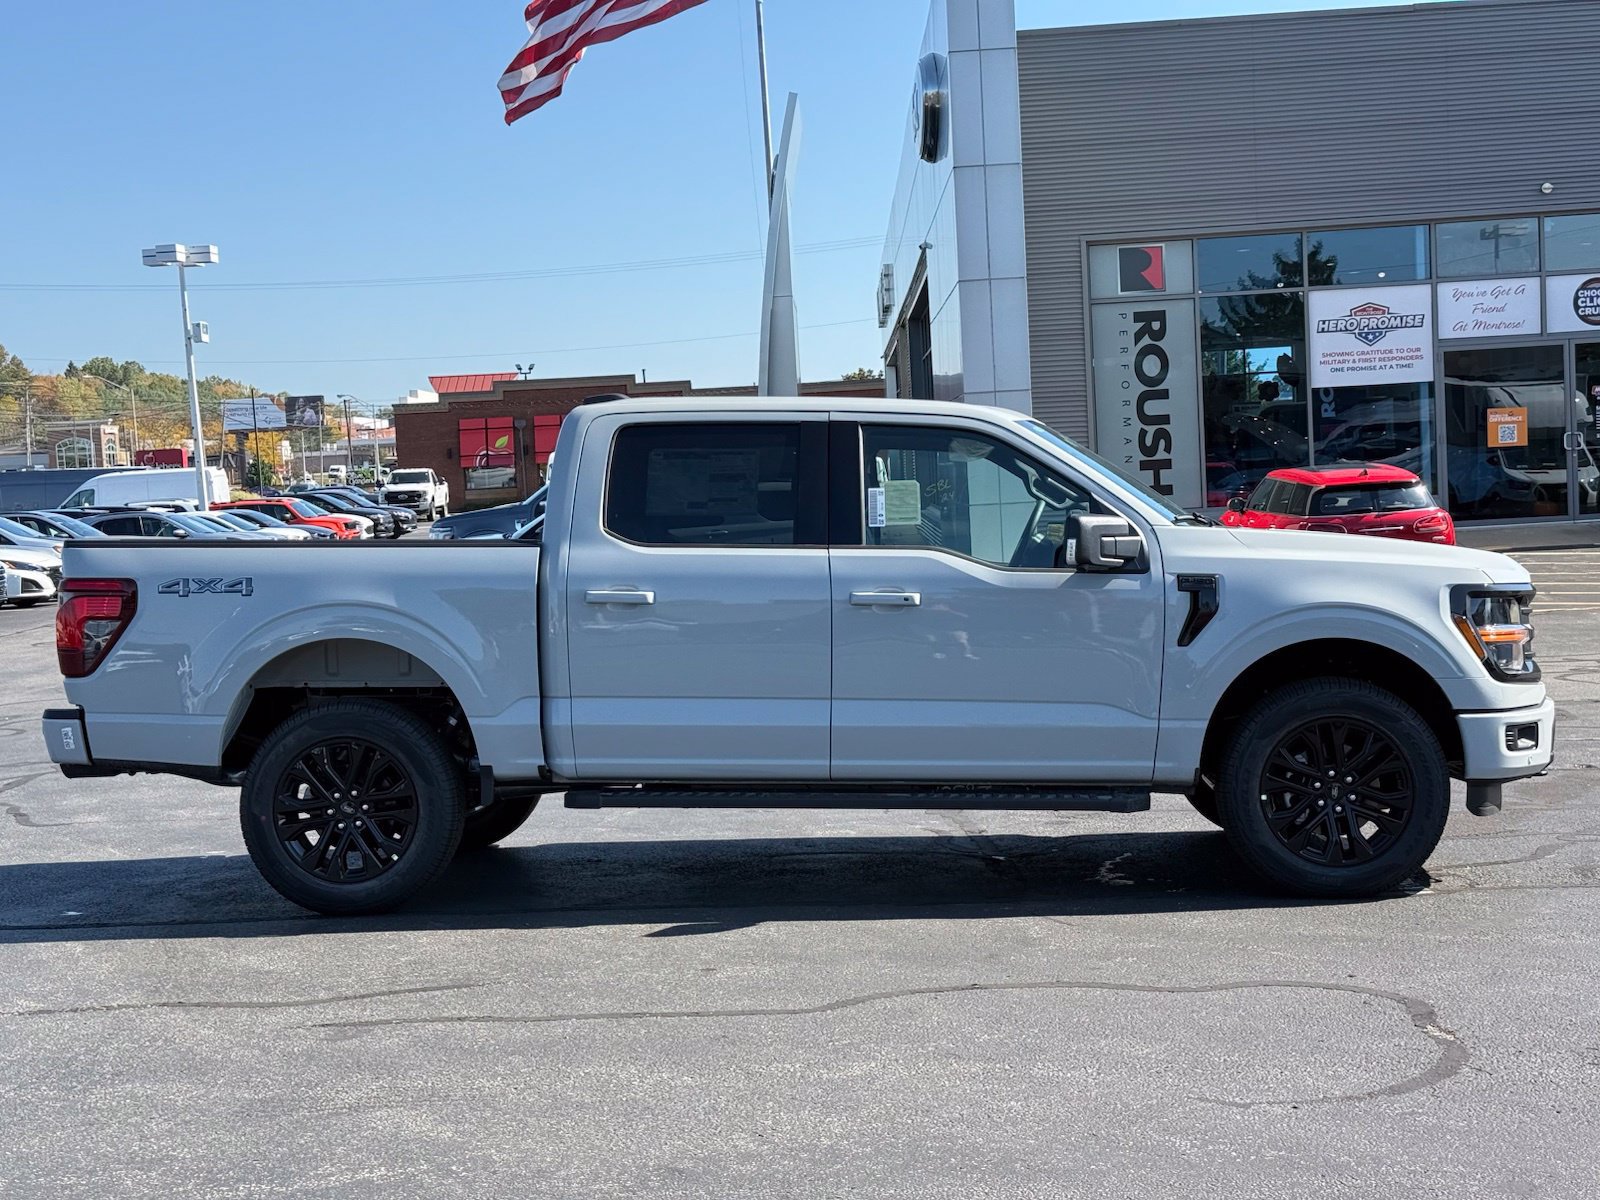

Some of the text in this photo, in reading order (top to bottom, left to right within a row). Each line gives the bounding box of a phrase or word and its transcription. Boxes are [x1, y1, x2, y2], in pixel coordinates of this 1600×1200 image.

[1452, 286, 1487, 302] You've
[1489, 285, 1512, 300] Got
[1471, 303, 1508, 315] Friend
[1317, 314, 1425, 333] HERO PROMISE
[1452, 319, 1526, 332] At Montrose!
[1356, 348, 1395, 356] GRATITUDE
[1319, 358, 1350, 366] MILITARY
[1378, 355, 1424, 363] RESPONDERS
[1133, 310, 1174, 495] ROUSH
